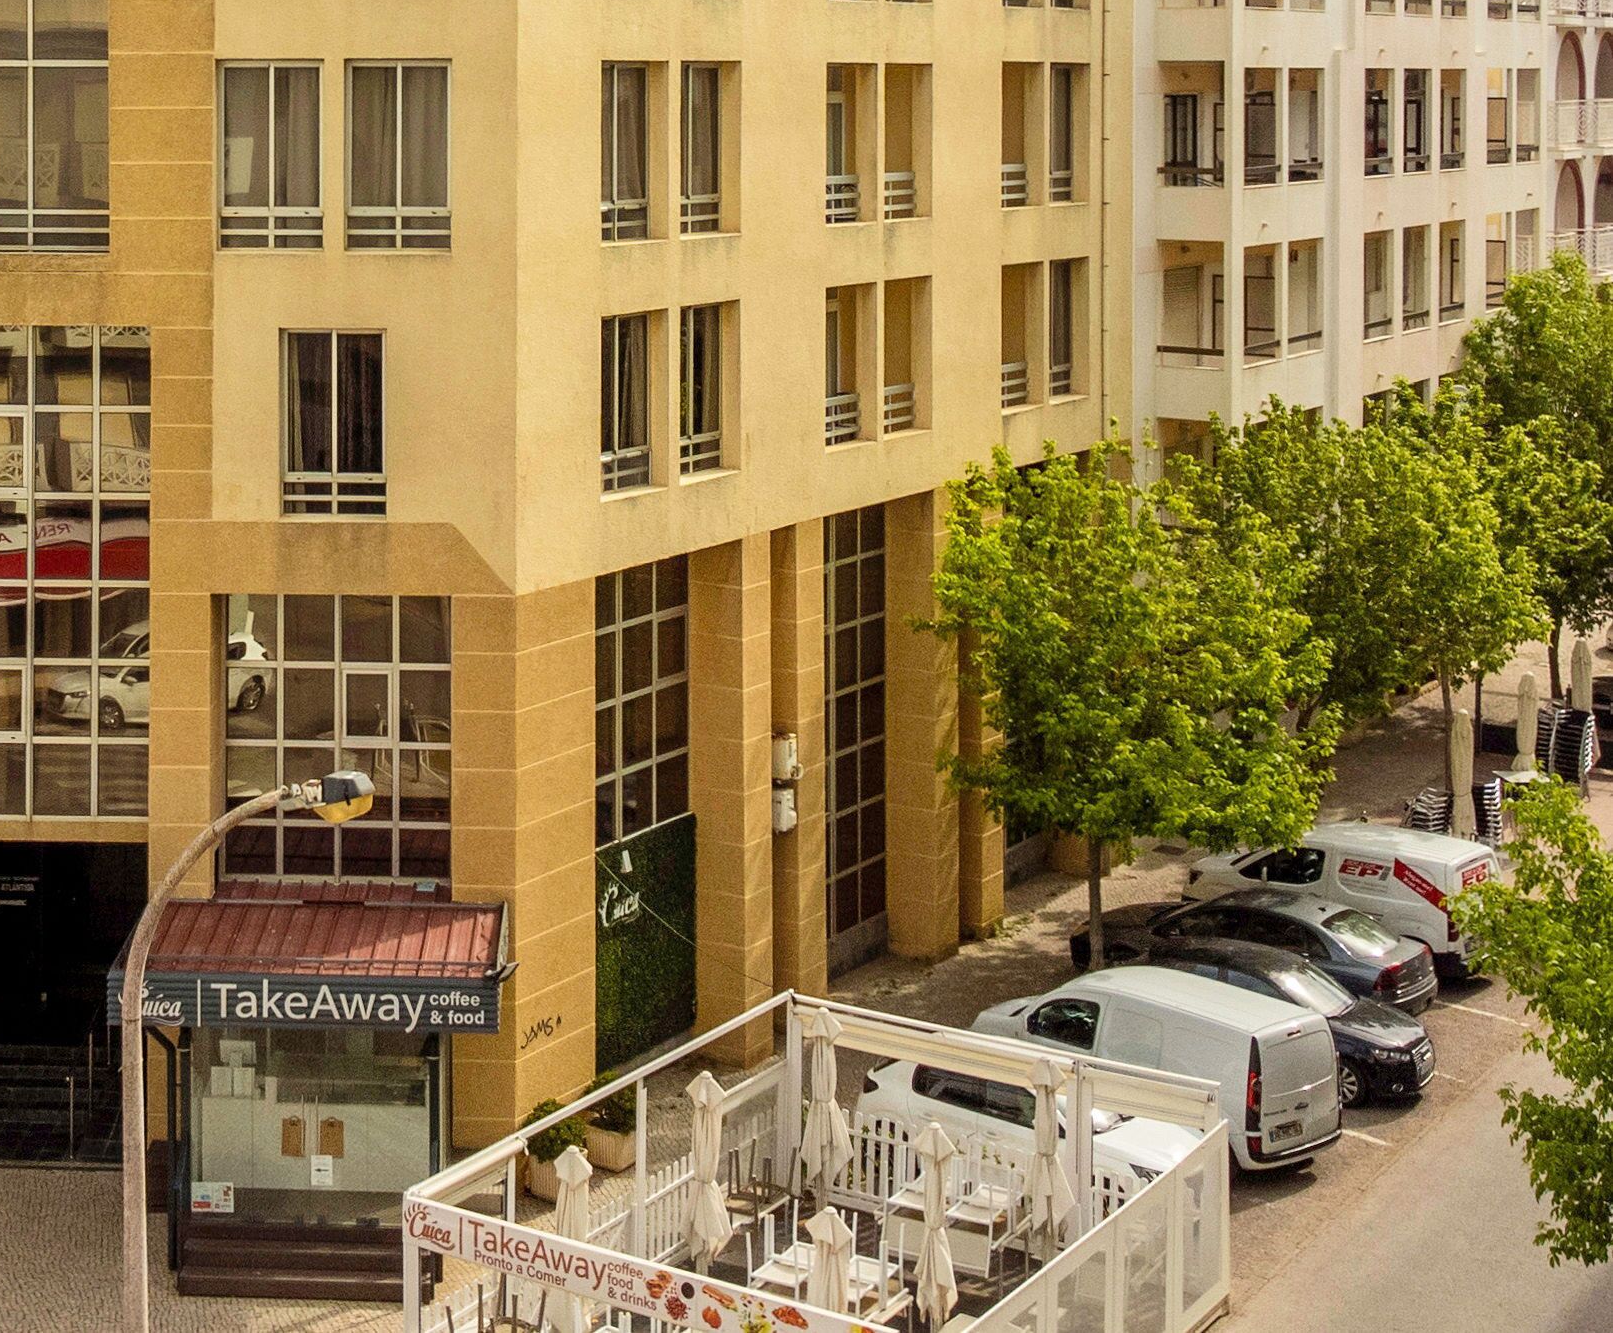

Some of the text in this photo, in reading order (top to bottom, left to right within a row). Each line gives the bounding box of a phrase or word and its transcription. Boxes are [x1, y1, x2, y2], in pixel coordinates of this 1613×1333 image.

[210, 978, 426, 1034] TakeAway
[429, 991, 481, 1007] coffee
[429, 1008, 485, 1025] & food
[467, 1219, 607, 1291] TakeAway
[473, 1249, 568, 1288] Pronto a Comer
[606, 1274, 634, 1291] food
[607, 1287, 658, 1312] & drinks
